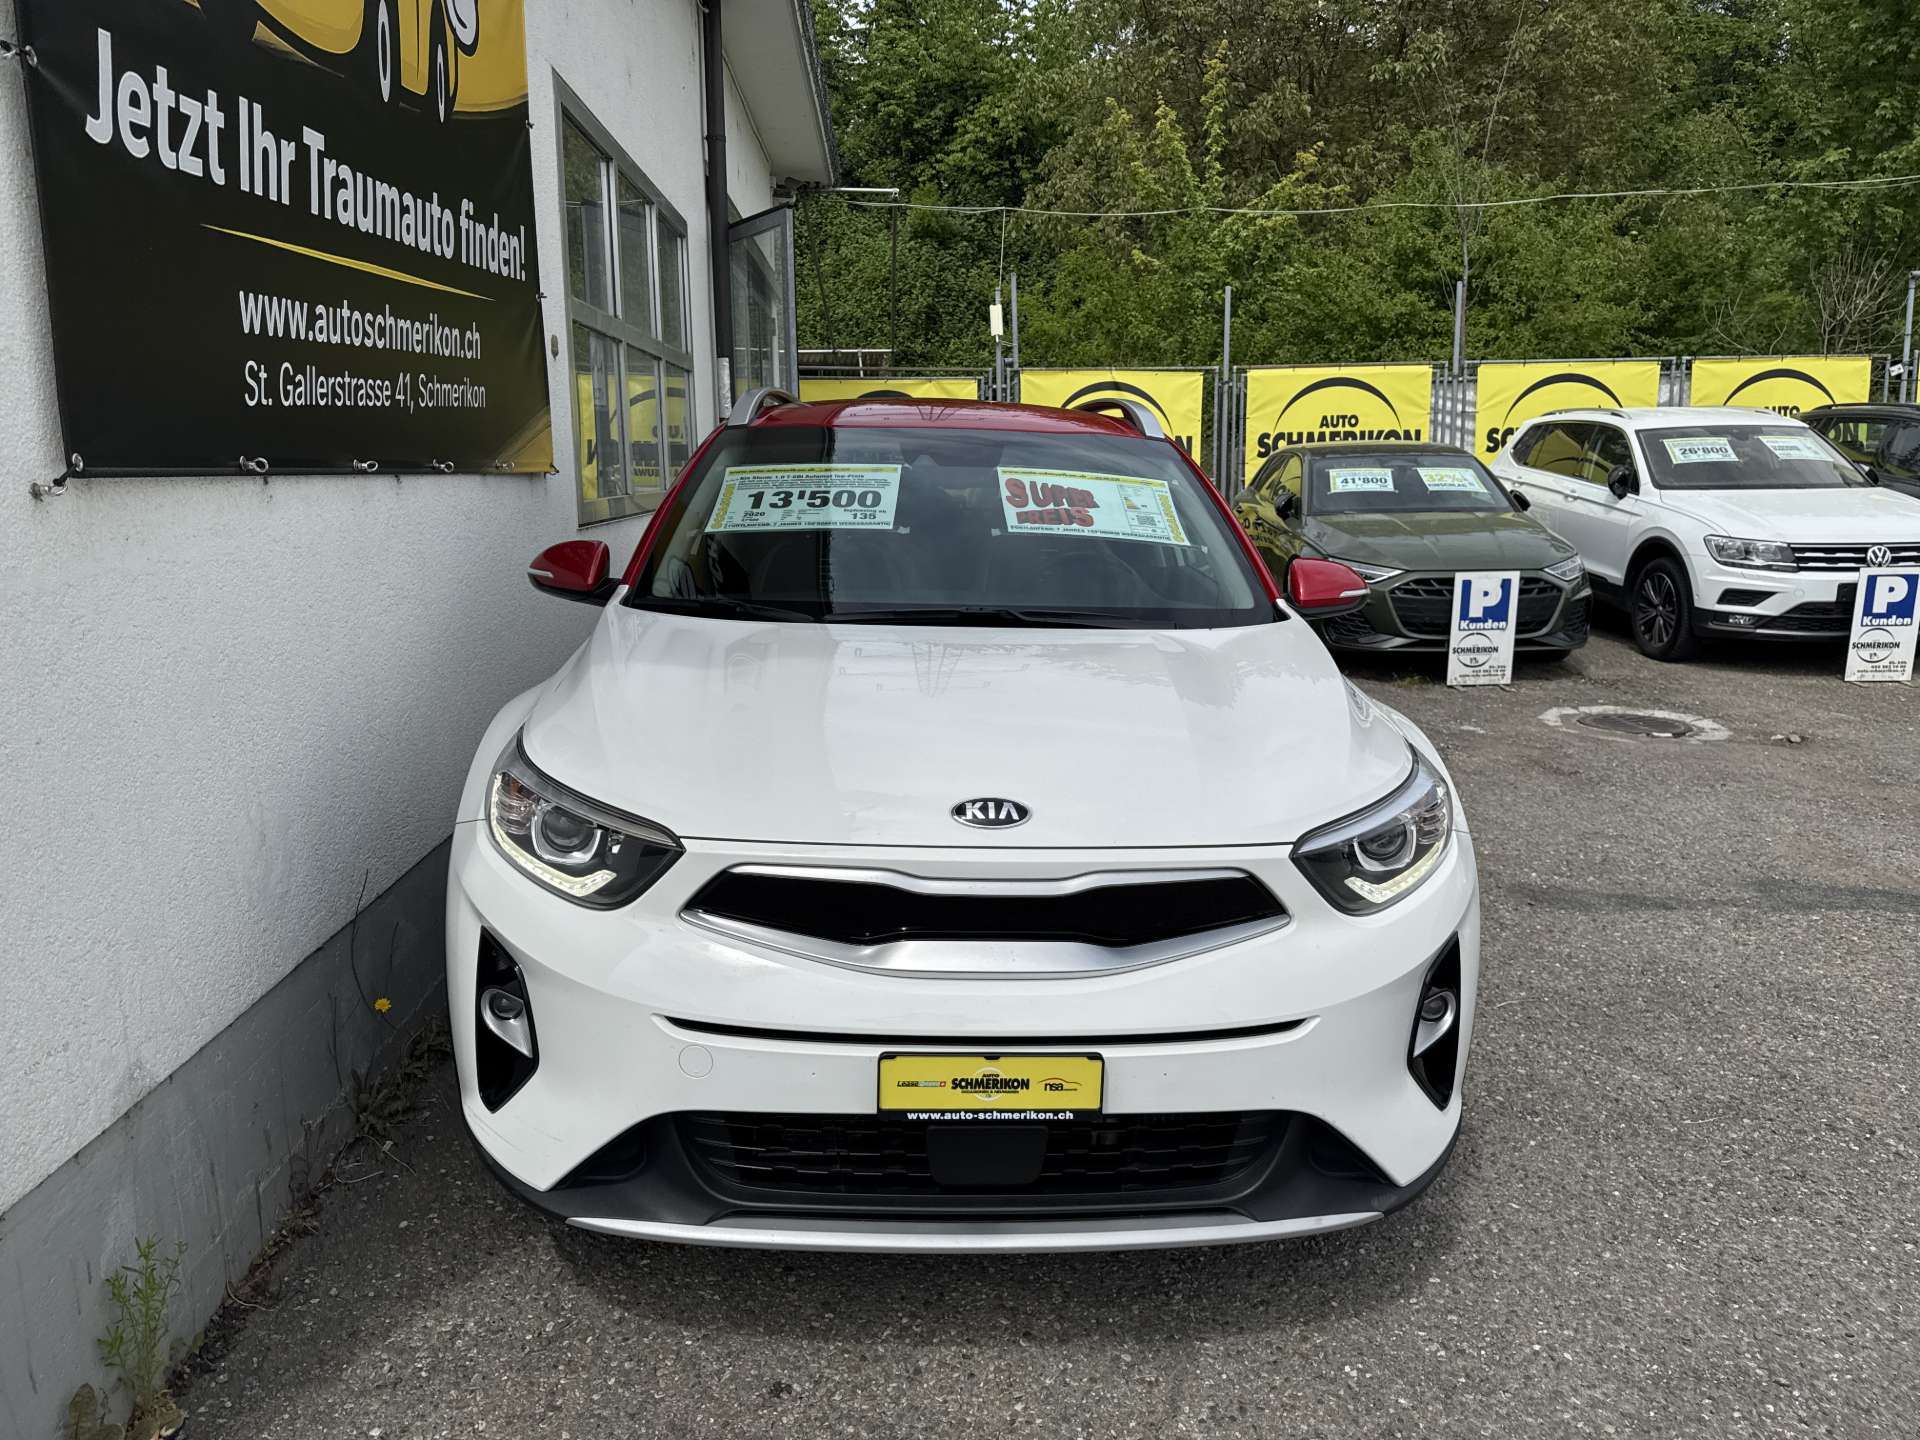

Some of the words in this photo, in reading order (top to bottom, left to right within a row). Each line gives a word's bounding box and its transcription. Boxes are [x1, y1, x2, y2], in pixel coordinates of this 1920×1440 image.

[85, 27, 226, 186] Jetzt
[239, 95, 296, 206] Ihr
[302, 125, 455, 260] Traumauto
[459, 198, 526, 282] finden!
[239, 290, 482, 360] www.autoschmerikon.ch
[244, 360, 273, 408] St.
[279, 361, 392, 408] Gallerstrasse
[395, 371, 414, 415] 41,
[418, 373, 486, 409] Schmerikon
[1319, 414, 1359, 429] AUTO
[1679, 446, 1729, 455] 26'800
[1340, 477, 1388, 485] 41'800
[747, 489, 883, 510] 13'500
[851, 512, 877, 520] 135
[1468, 578, 1502, 618] P
[1872, 576, 1909, 613] P
[1460, 619, 1507, 630] Kunden
[1862, 615, 1912, 626] Kunden
[1452, 646, 1499, 655] SCHMERIKON
[1852, 641, 1901, 650] SCHMERIKON
[961, 801, 1020, 820] KIA
[951, 1078, 1030, 1090] SCHMERIKON
[1044, 1082, 1064, 1092] nsa
[906, 1109, 1074, 1121] www.auto-schmerikon.ch
